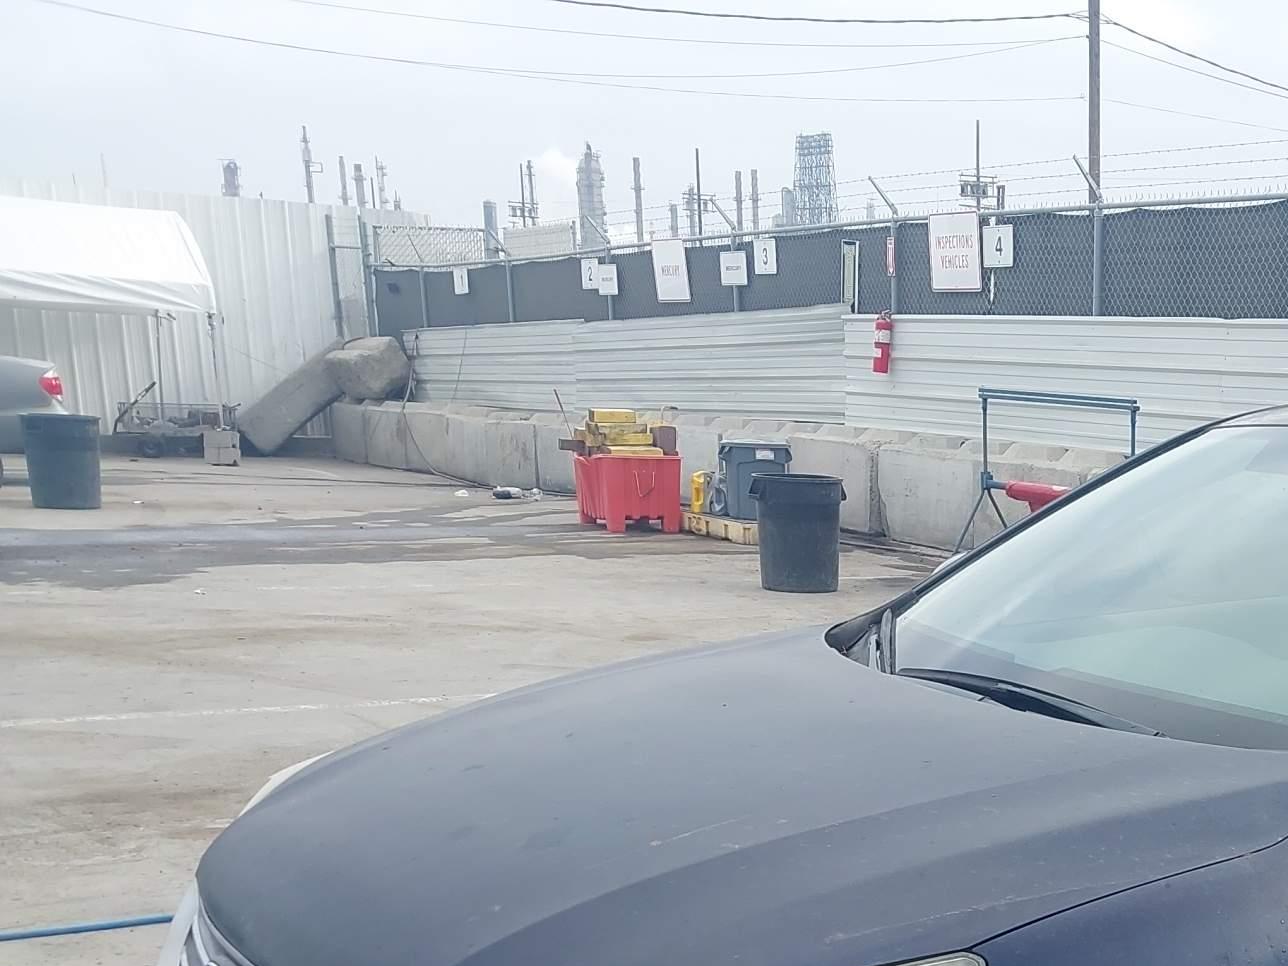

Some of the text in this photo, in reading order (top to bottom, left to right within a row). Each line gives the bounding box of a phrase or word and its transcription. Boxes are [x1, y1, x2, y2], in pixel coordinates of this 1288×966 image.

[935, 233, 974, 250] INSPECTIONS
[994, 235, 1004, 257] 4
[761, 247, 769, 266] 3
[940, 254, 969, 270] VEHICLES
[587, 266, 593, 282] 2
